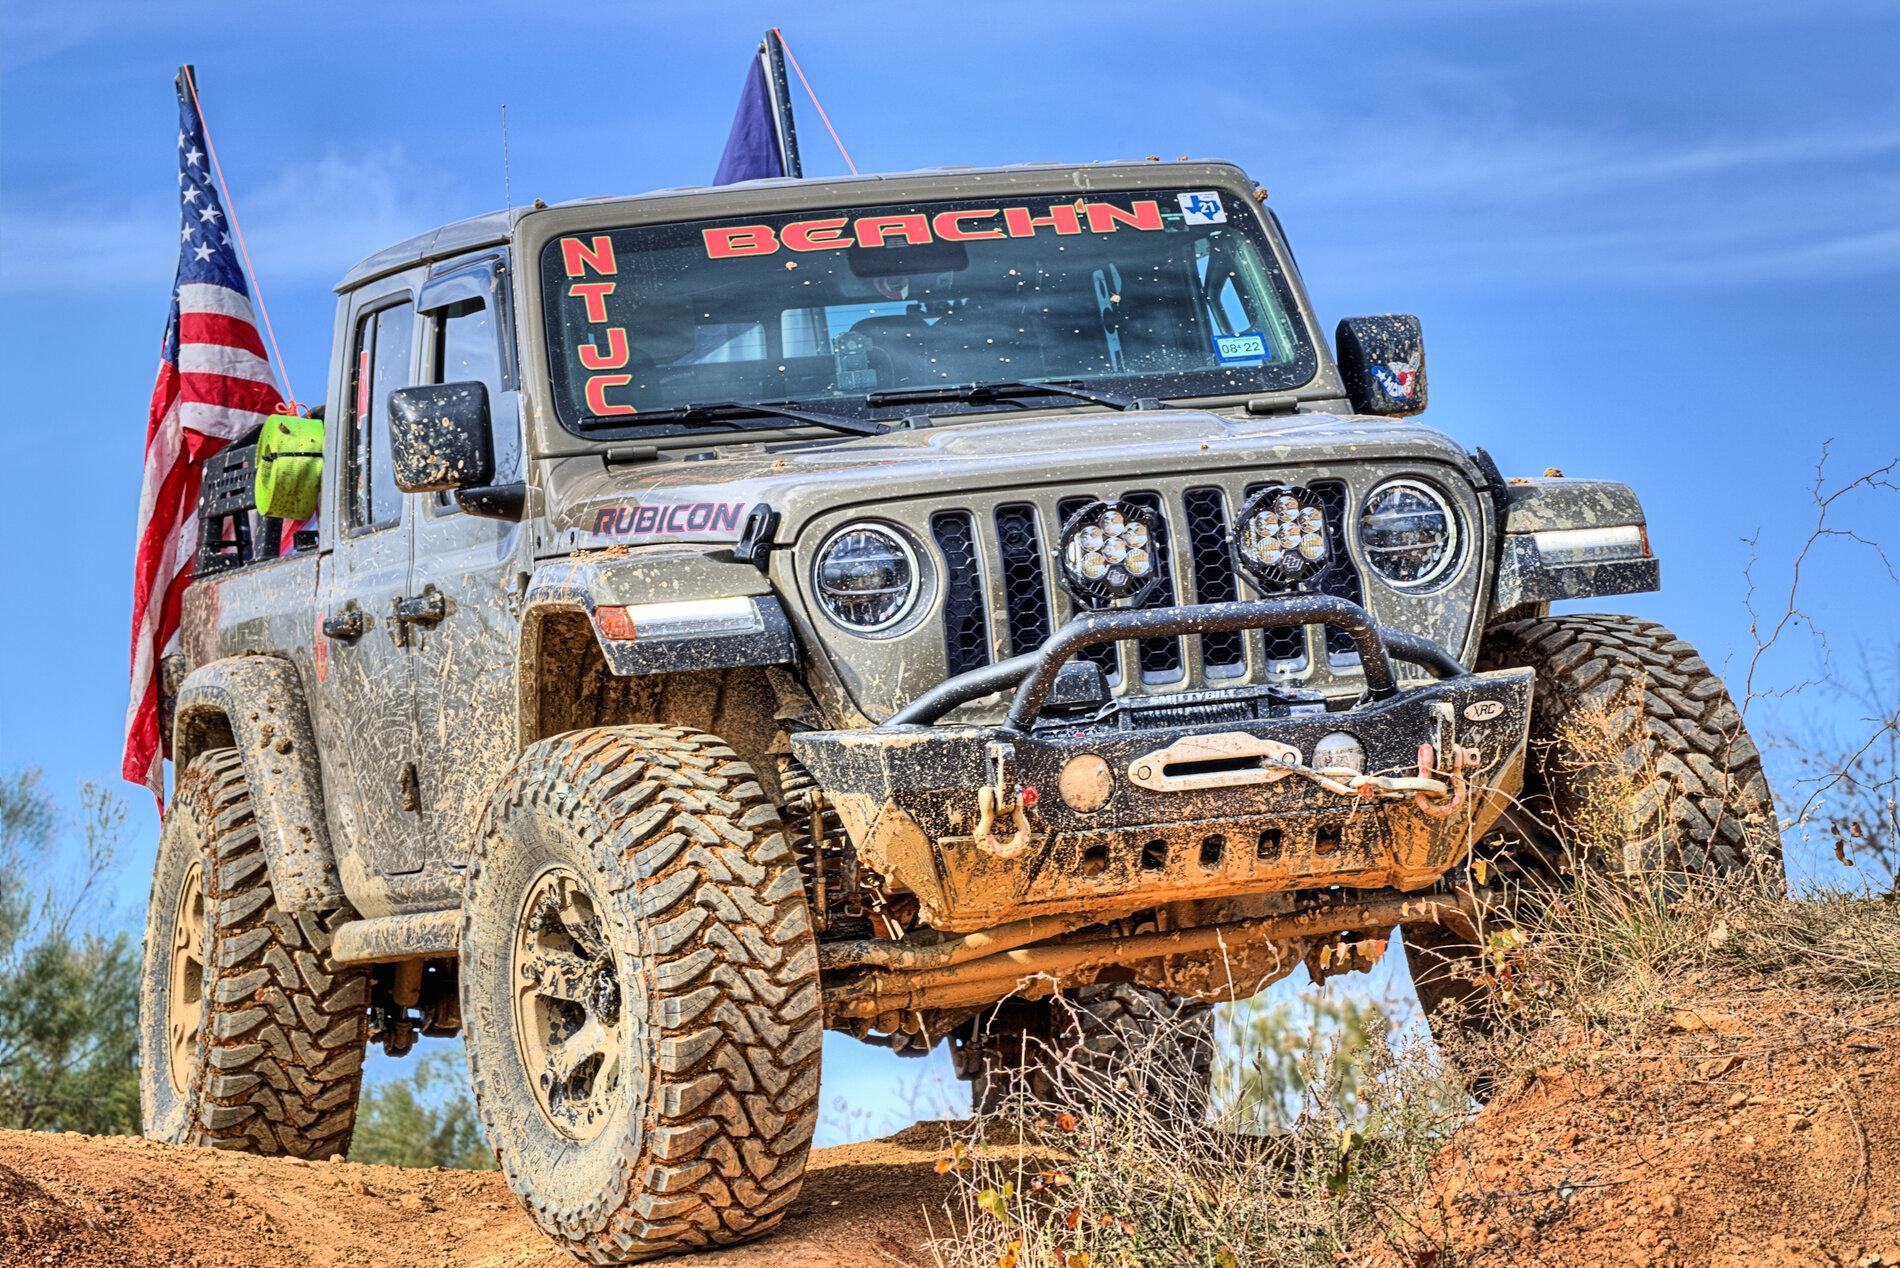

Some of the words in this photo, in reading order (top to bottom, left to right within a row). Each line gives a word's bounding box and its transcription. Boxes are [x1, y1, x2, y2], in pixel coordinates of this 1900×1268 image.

[1199, 201, 1216, 213] 21
[702, 197, 1164, 259] BEACH'N
[592, 502, 746, 537] RUBICON
[1149, 689, 1237, 704] SMITTYBILT
[1473, 703, 1496, 717] XRC
